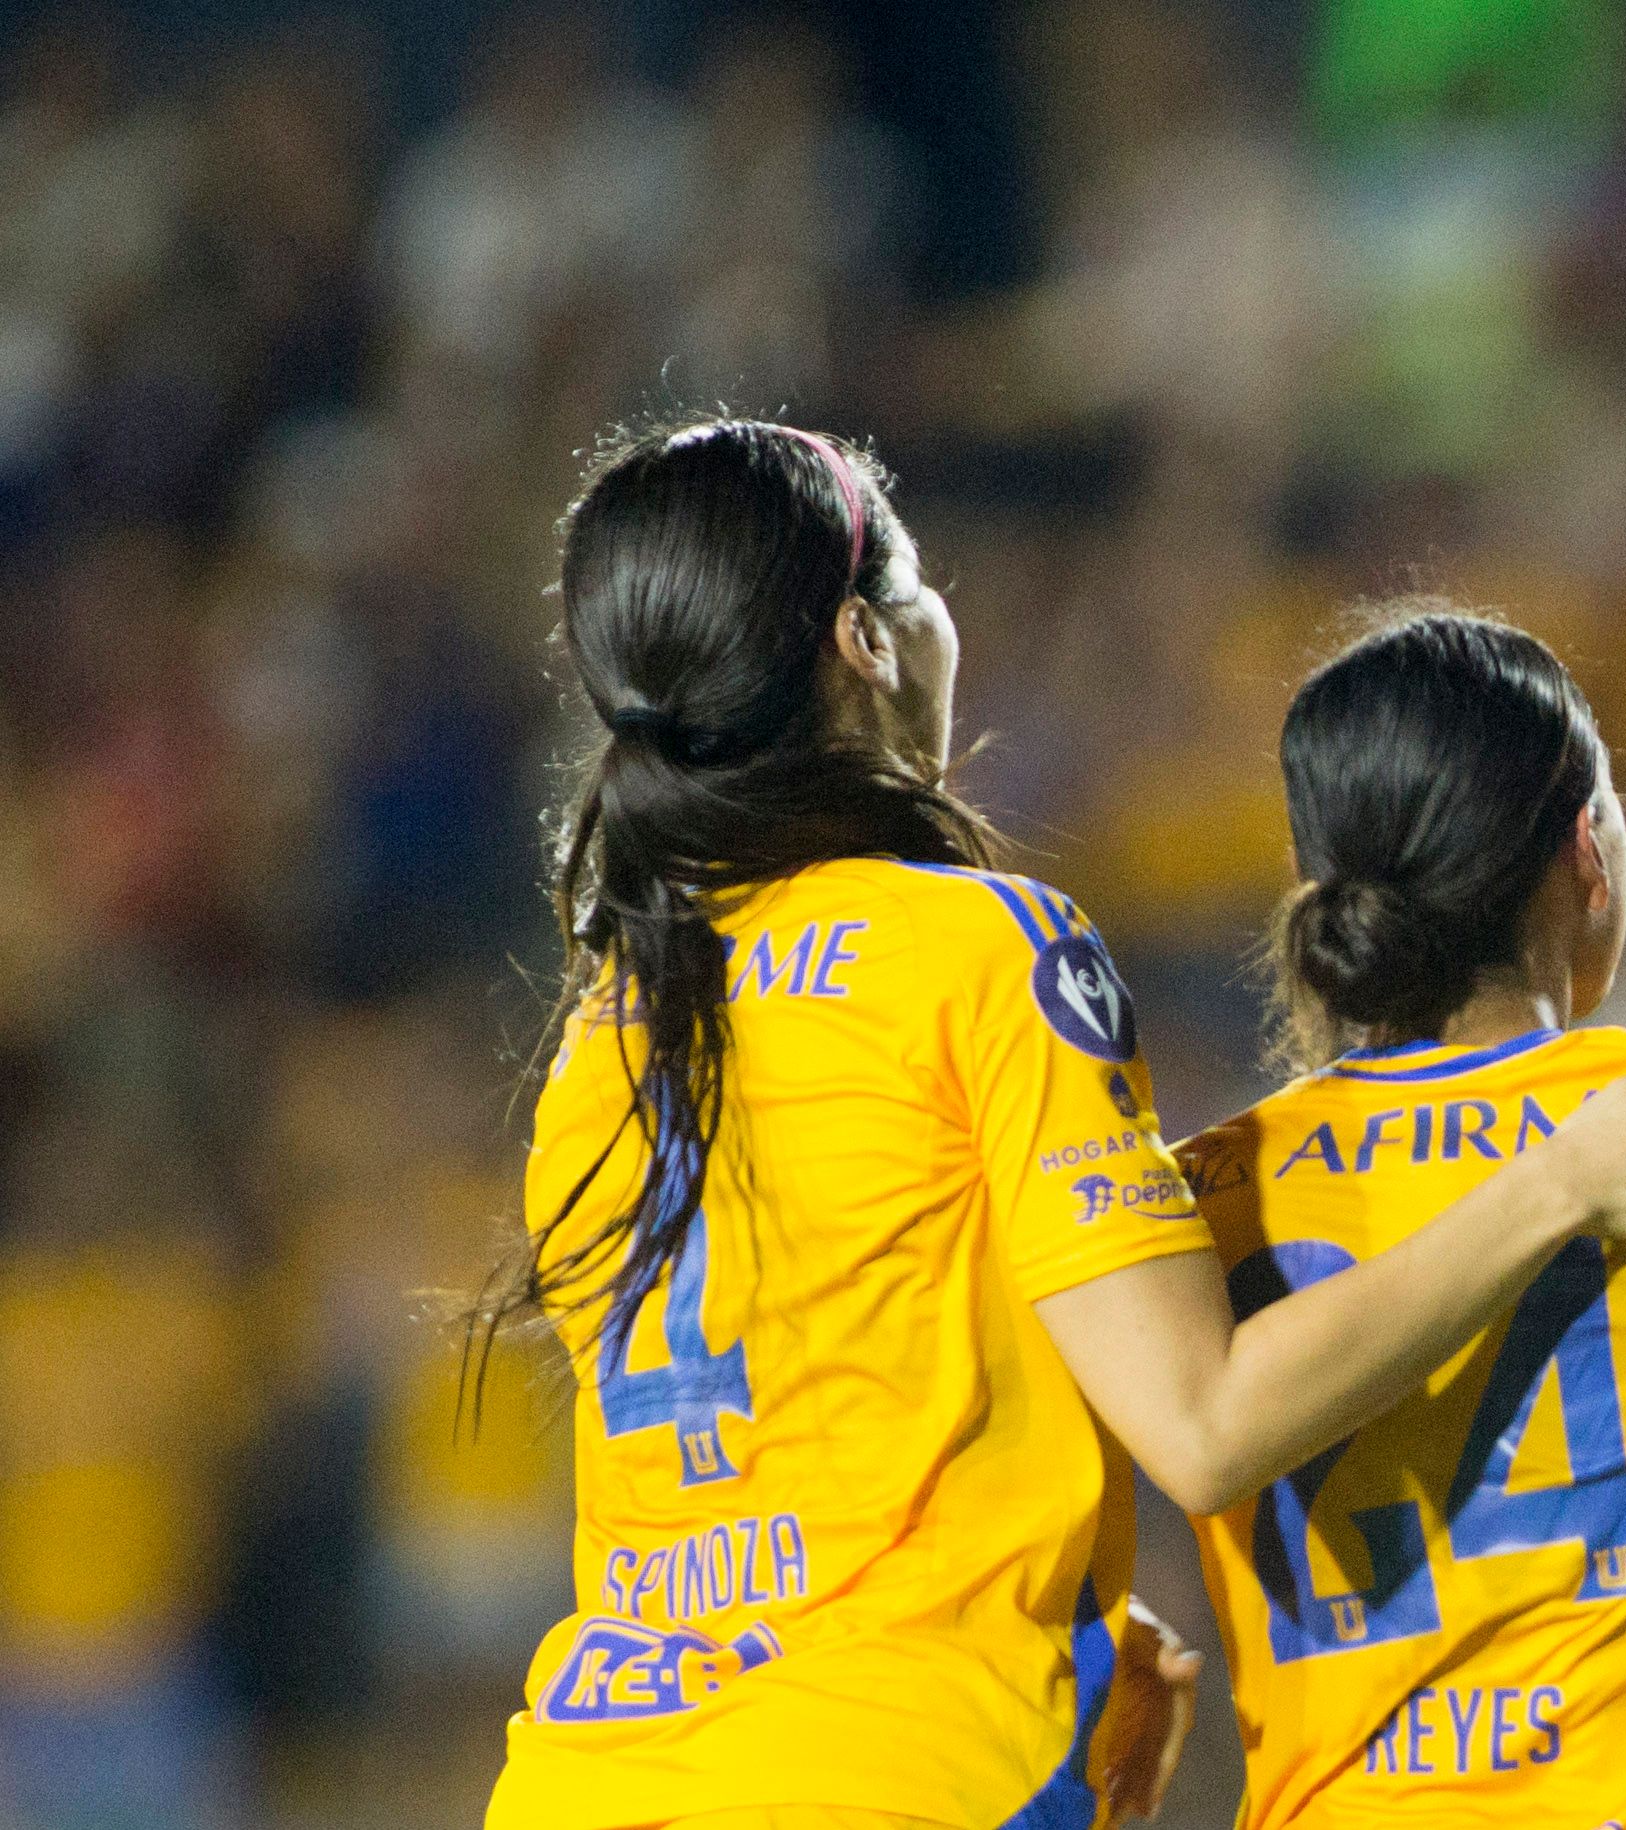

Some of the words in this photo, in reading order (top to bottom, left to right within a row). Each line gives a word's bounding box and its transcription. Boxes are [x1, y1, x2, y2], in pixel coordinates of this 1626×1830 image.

[1274, 1089, 1598, 1179] AFIRM
[597, 1068, 756, 1488] 4
[1365, 1687, 1561, 1773] REYES
